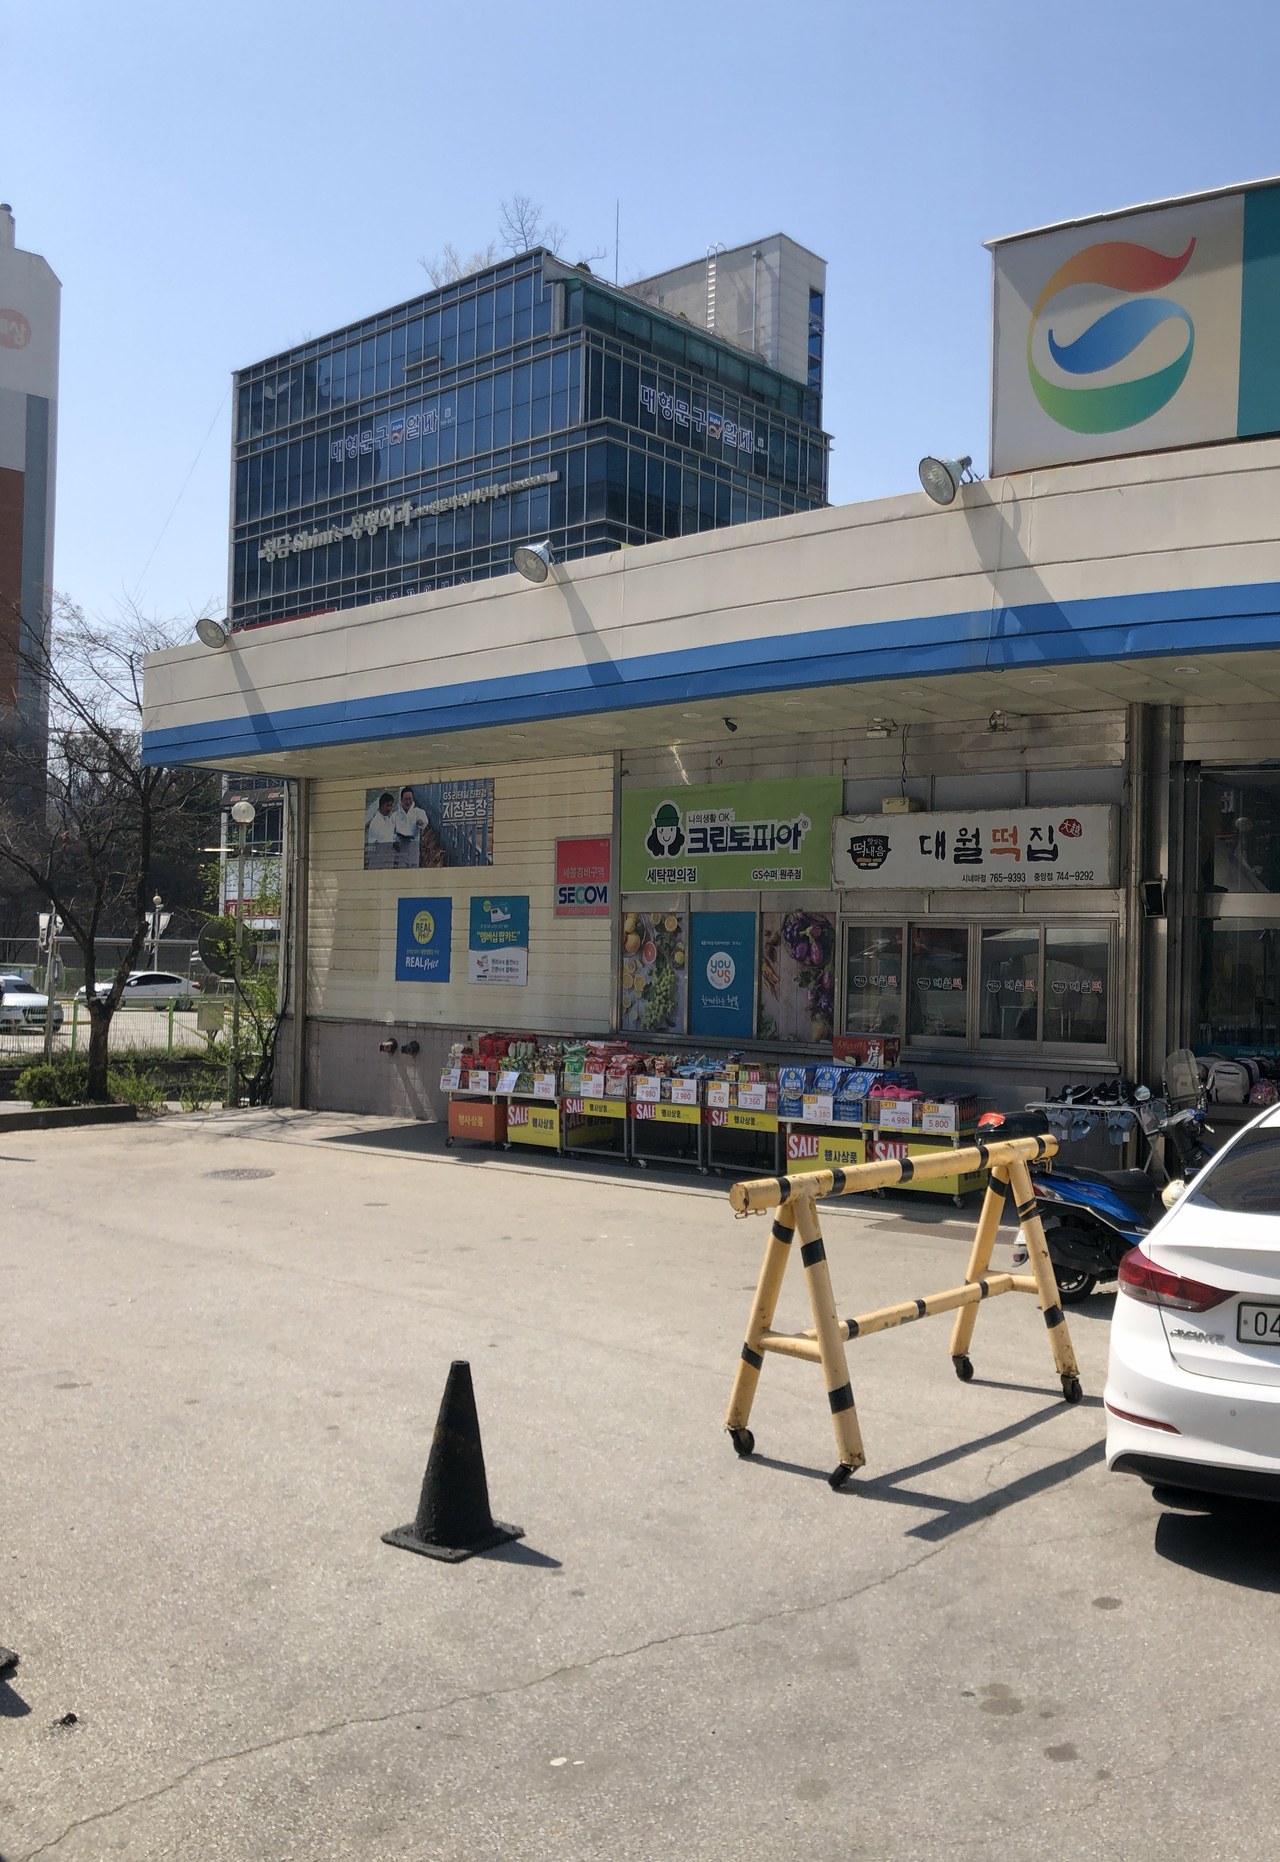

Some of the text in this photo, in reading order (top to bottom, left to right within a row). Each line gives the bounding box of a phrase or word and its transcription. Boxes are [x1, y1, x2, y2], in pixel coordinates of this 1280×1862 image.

[640, 385, 707, 433] 대형문구
[724, 420, 753, 454] 알파
[330, 424, 389, 462] 대형문구
[406, 409, 438, 440] 알파
[349, 499, 414, 540] 성형외과
[442, 799, 488, 818] 지정농장
[688, 813, 716, 823] 나의생활
[687, 823, 802, 854] 크린토피아
[919, 824, 1059, 864] 대월떡집
[853, 841, 886, 857] 떡내음
[647, 868, 697, 883] 세탁편의점
[752, 869, 802, 881] GS수퍼 원주점
[962, 871, 1094, 883] 시네마점 765-9393 중앙점 744-9292
[558, 886, 608, 905] SECOM
[415, 922, 432, 933] REAL
[406, 956, 424, 968] REAL
[710, 960, 731, 973] you
[717, 969, 731, 983] us
[566, 1098, 584, 1114] SALE
[590, 1103, 608, 1112] 행사상품
[636, 1103, 656, 1119] SALE
[661, 1109, 682, 1118] 행사상품
[459, 1114, 484, 1128] 행사상품
[508, 1105, 528, 1125] SALE
[734, 1115, 756, 1126] 행사상품
[532, 1116, 554, 1130] 행사상품
[788, 1135, 819, 1159] SALE
[875, 1143, 909, 1162] SALE
[824, 1149, 858, 1164] 행사상품
